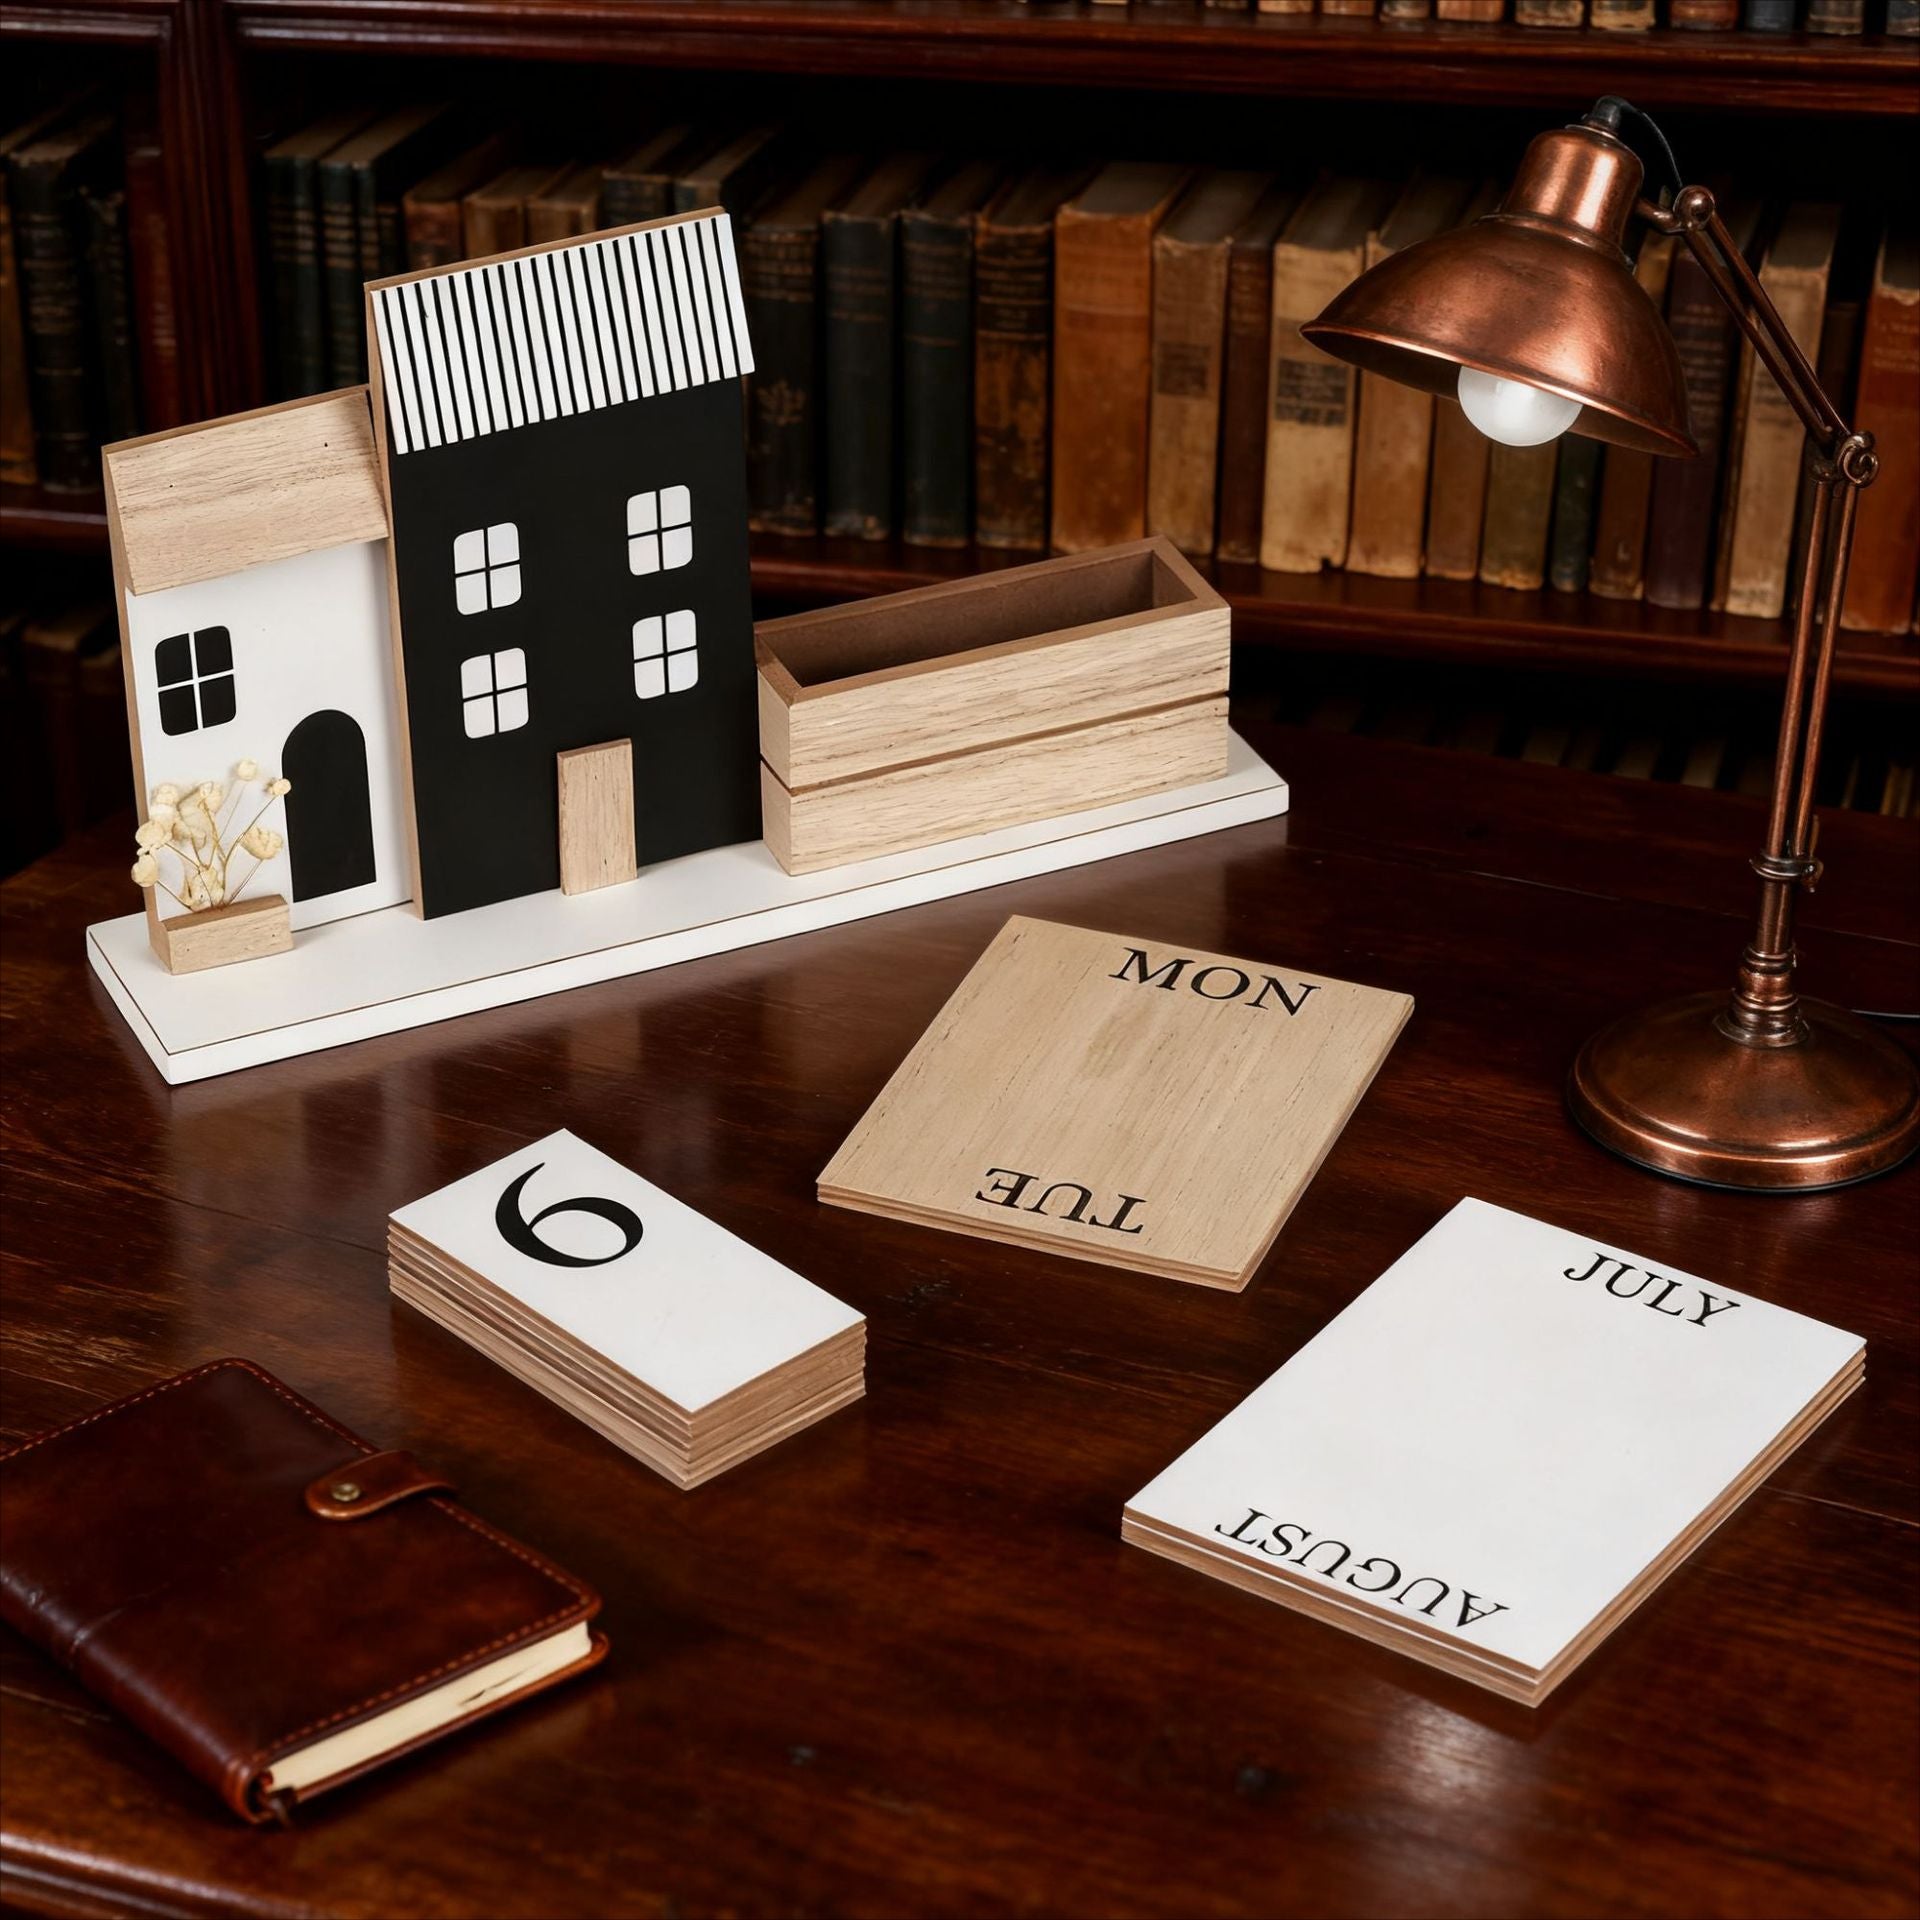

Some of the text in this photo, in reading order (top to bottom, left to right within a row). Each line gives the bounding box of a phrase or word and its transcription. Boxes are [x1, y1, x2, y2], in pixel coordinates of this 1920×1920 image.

[1108, 947, 1322, 1017] MON
[494, 1161, 644, 1268] 6
[975, 1167, 1147, 1234] TUE
[1563, 1252, 1742, 1327] JULY
[1214, 1508, 1510, 1627] AUGUST
